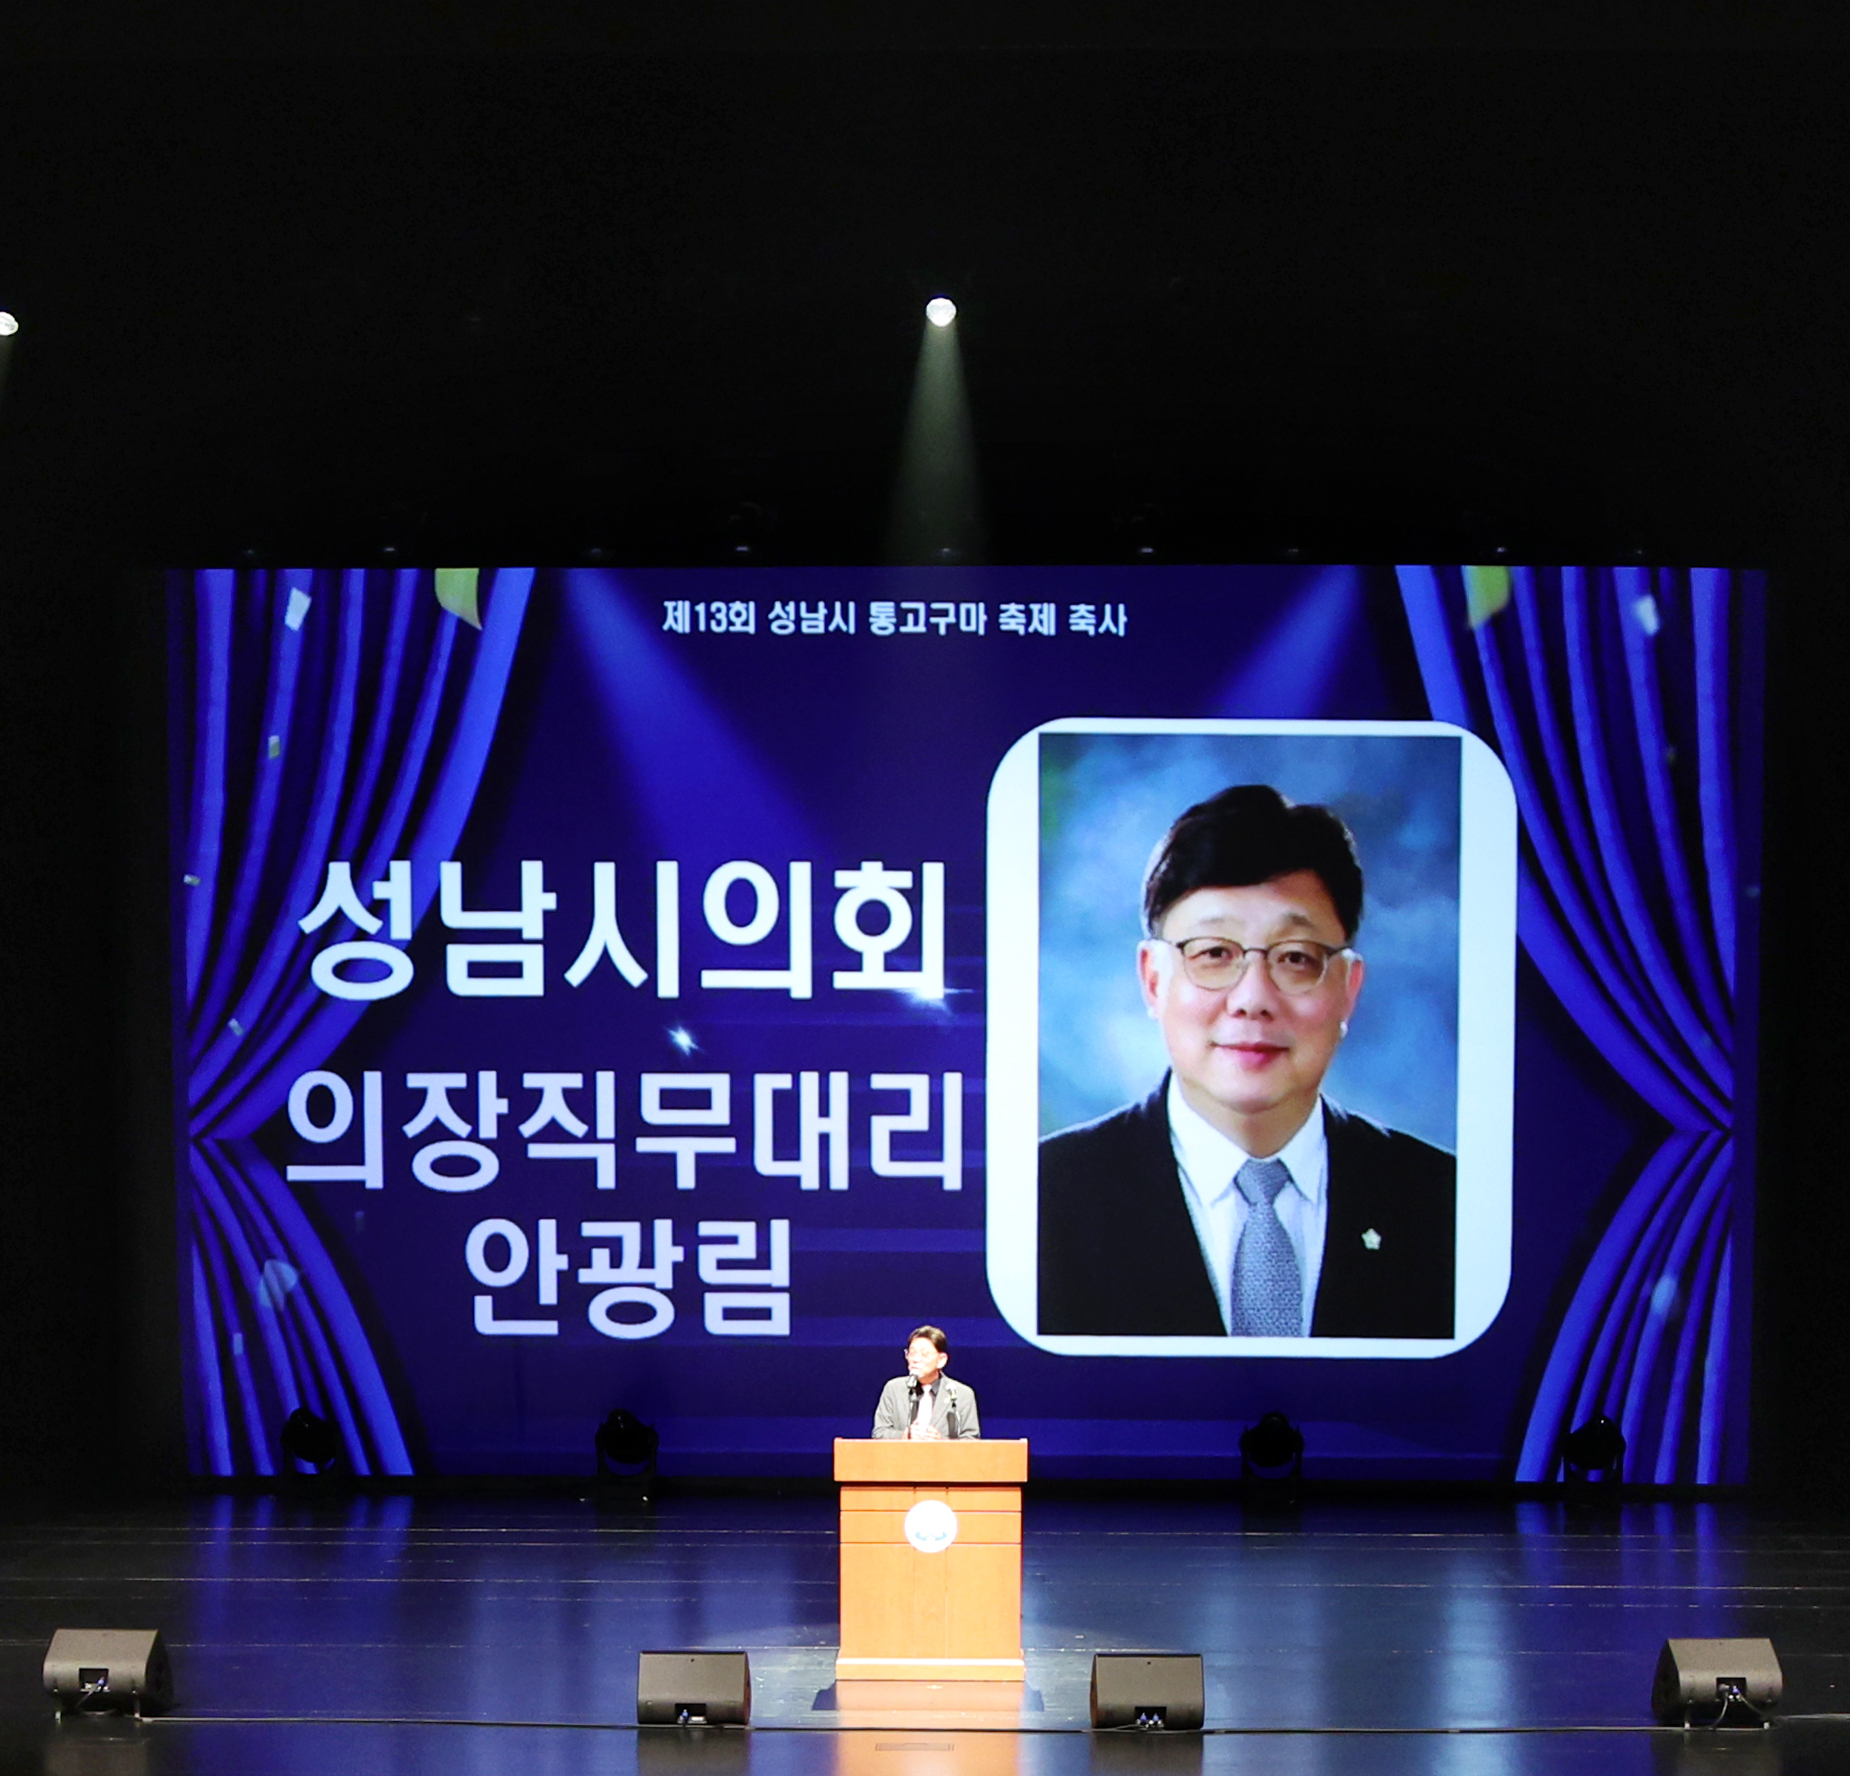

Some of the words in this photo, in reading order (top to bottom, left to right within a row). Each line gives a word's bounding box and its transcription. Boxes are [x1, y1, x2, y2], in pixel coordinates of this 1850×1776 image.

[662, 600, 756, 635] 제13회
[767, 600, 856, 636] 성남시
[868, 600, 988, 637] 통고구마
[998, 602, 1056, 637] 축제
[1068, 602, 1128, 637] 축사
[299, 860, 946, 999] 성남시의회
[286, 1069, 963, 1192] 의장직무대리
[465, 1217, 791, 1339] 안광림
